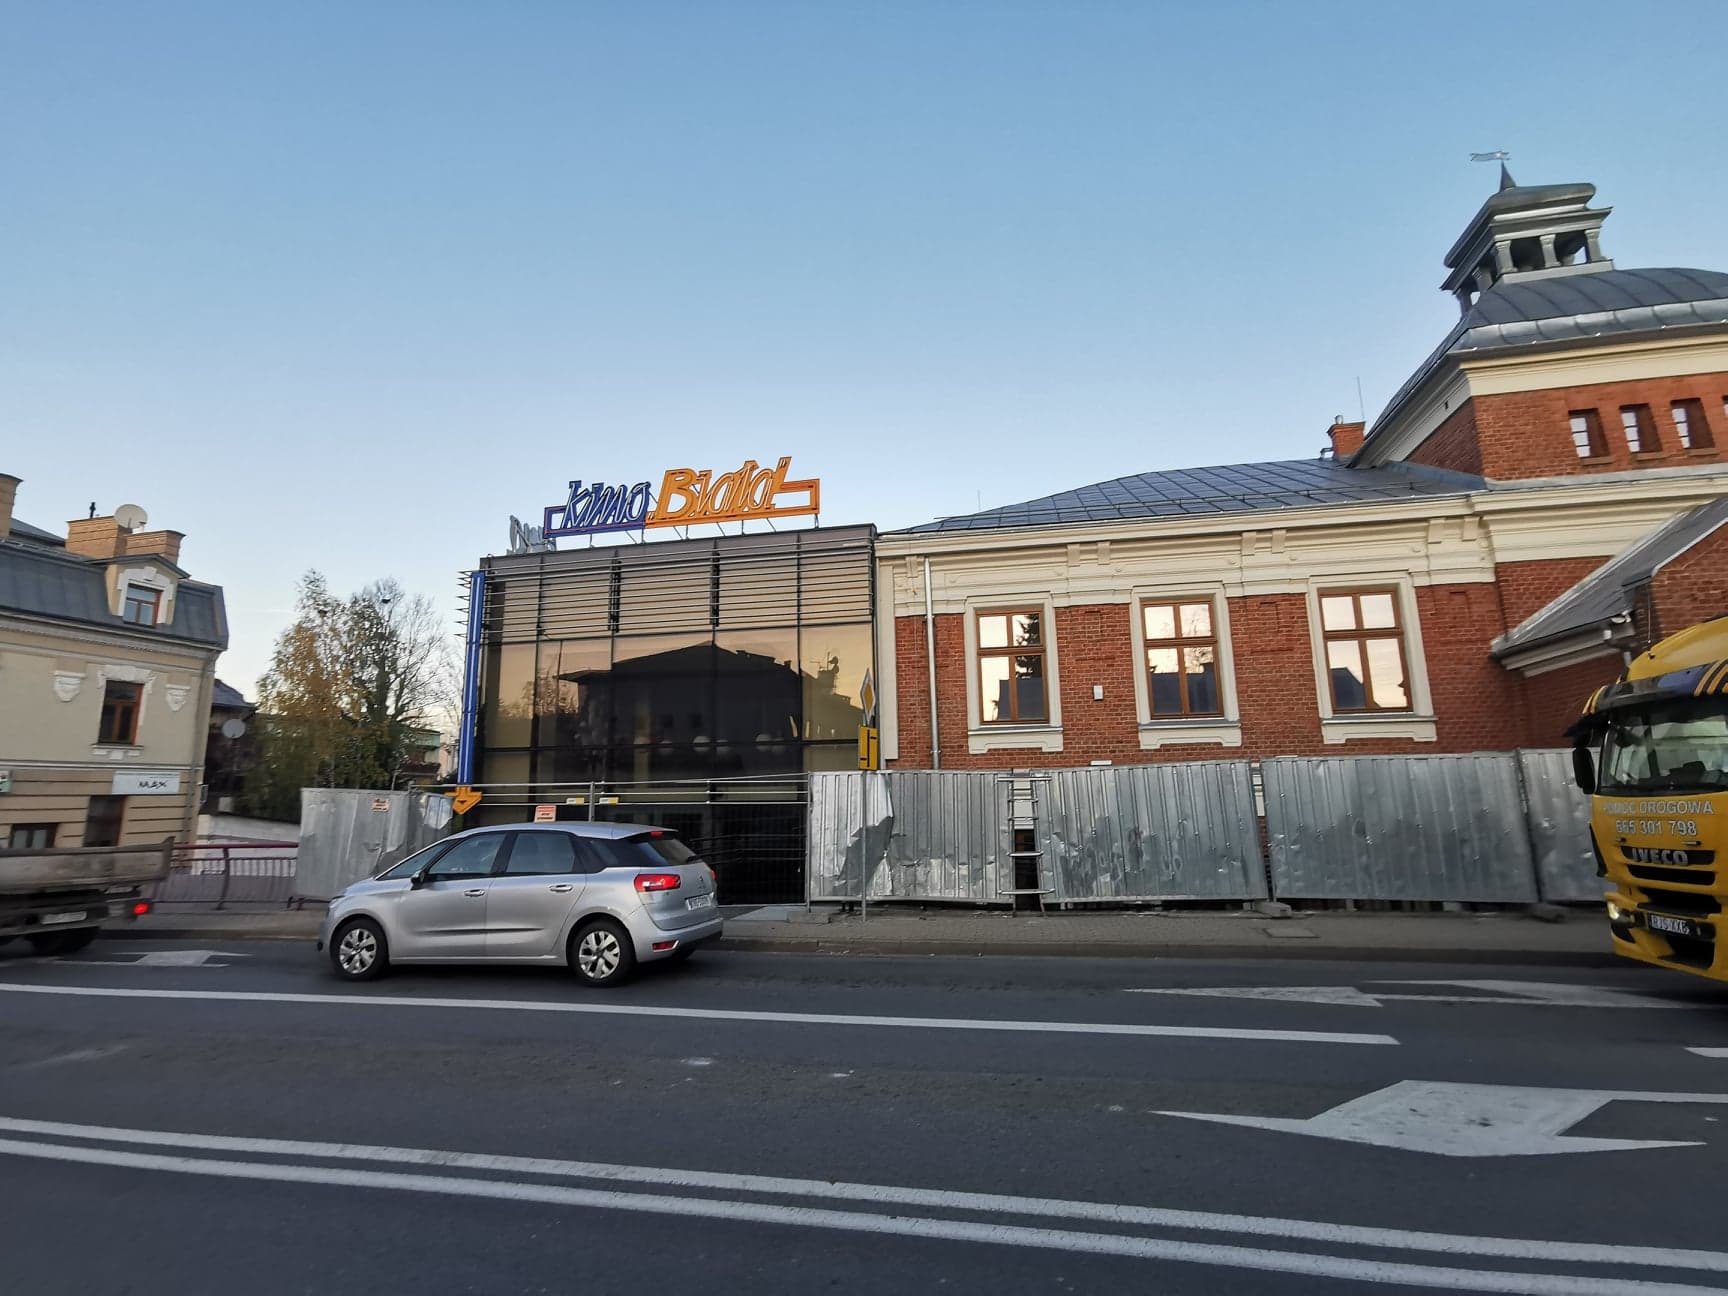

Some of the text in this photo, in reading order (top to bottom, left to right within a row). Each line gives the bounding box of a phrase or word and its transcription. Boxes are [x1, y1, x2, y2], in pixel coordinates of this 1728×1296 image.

[560, 480, 652, 528] kino
[1639, 800, 1714, 815] DROGOWA
[1640, 820, 1663, 835] 301
[1669, 820, 1697, 837] 798
[1631, 847, 1689, 866] IVECO
